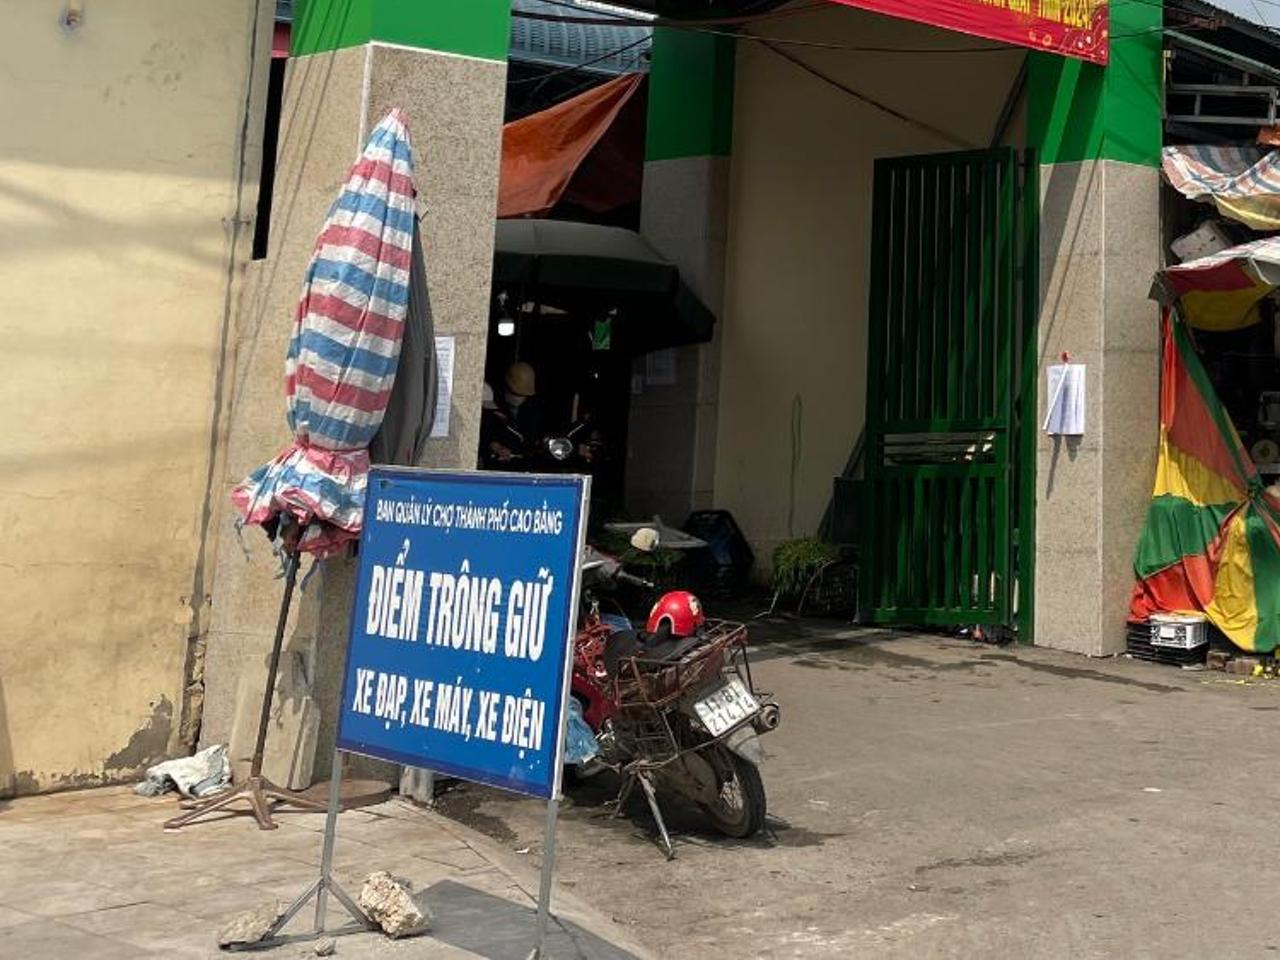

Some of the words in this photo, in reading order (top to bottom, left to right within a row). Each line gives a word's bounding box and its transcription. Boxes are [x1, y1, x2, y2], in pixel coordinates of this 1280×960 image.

[376, 499, 395, 522] BAN
[395, 495, 421, 525] QUẢN
[421, 498, 433, 525] LÝ
[433, 504, 454, 534] CHỢ
[455, 500, 487, 529] THÀNH
[487, 498, 510, 531] PHỐ
[510, 508, 532, 533] CAO
[533, 499, 562, 535] BẰNG
[366, 538, 424, 641] ĐIỂM
[427, 559, 502, 654] TRÔNG
[505, 566, 554, 662] GIỮ
[353, 668, 375, 712] XE
[375, 671, 407, 729] ĐẠP,
[409, 679, 433, 727] XE
[434, 675, 472, 742] MÁY,
[475, 690, 500, 741] XE
[501, 688, 546, 759] ĐIỆN
